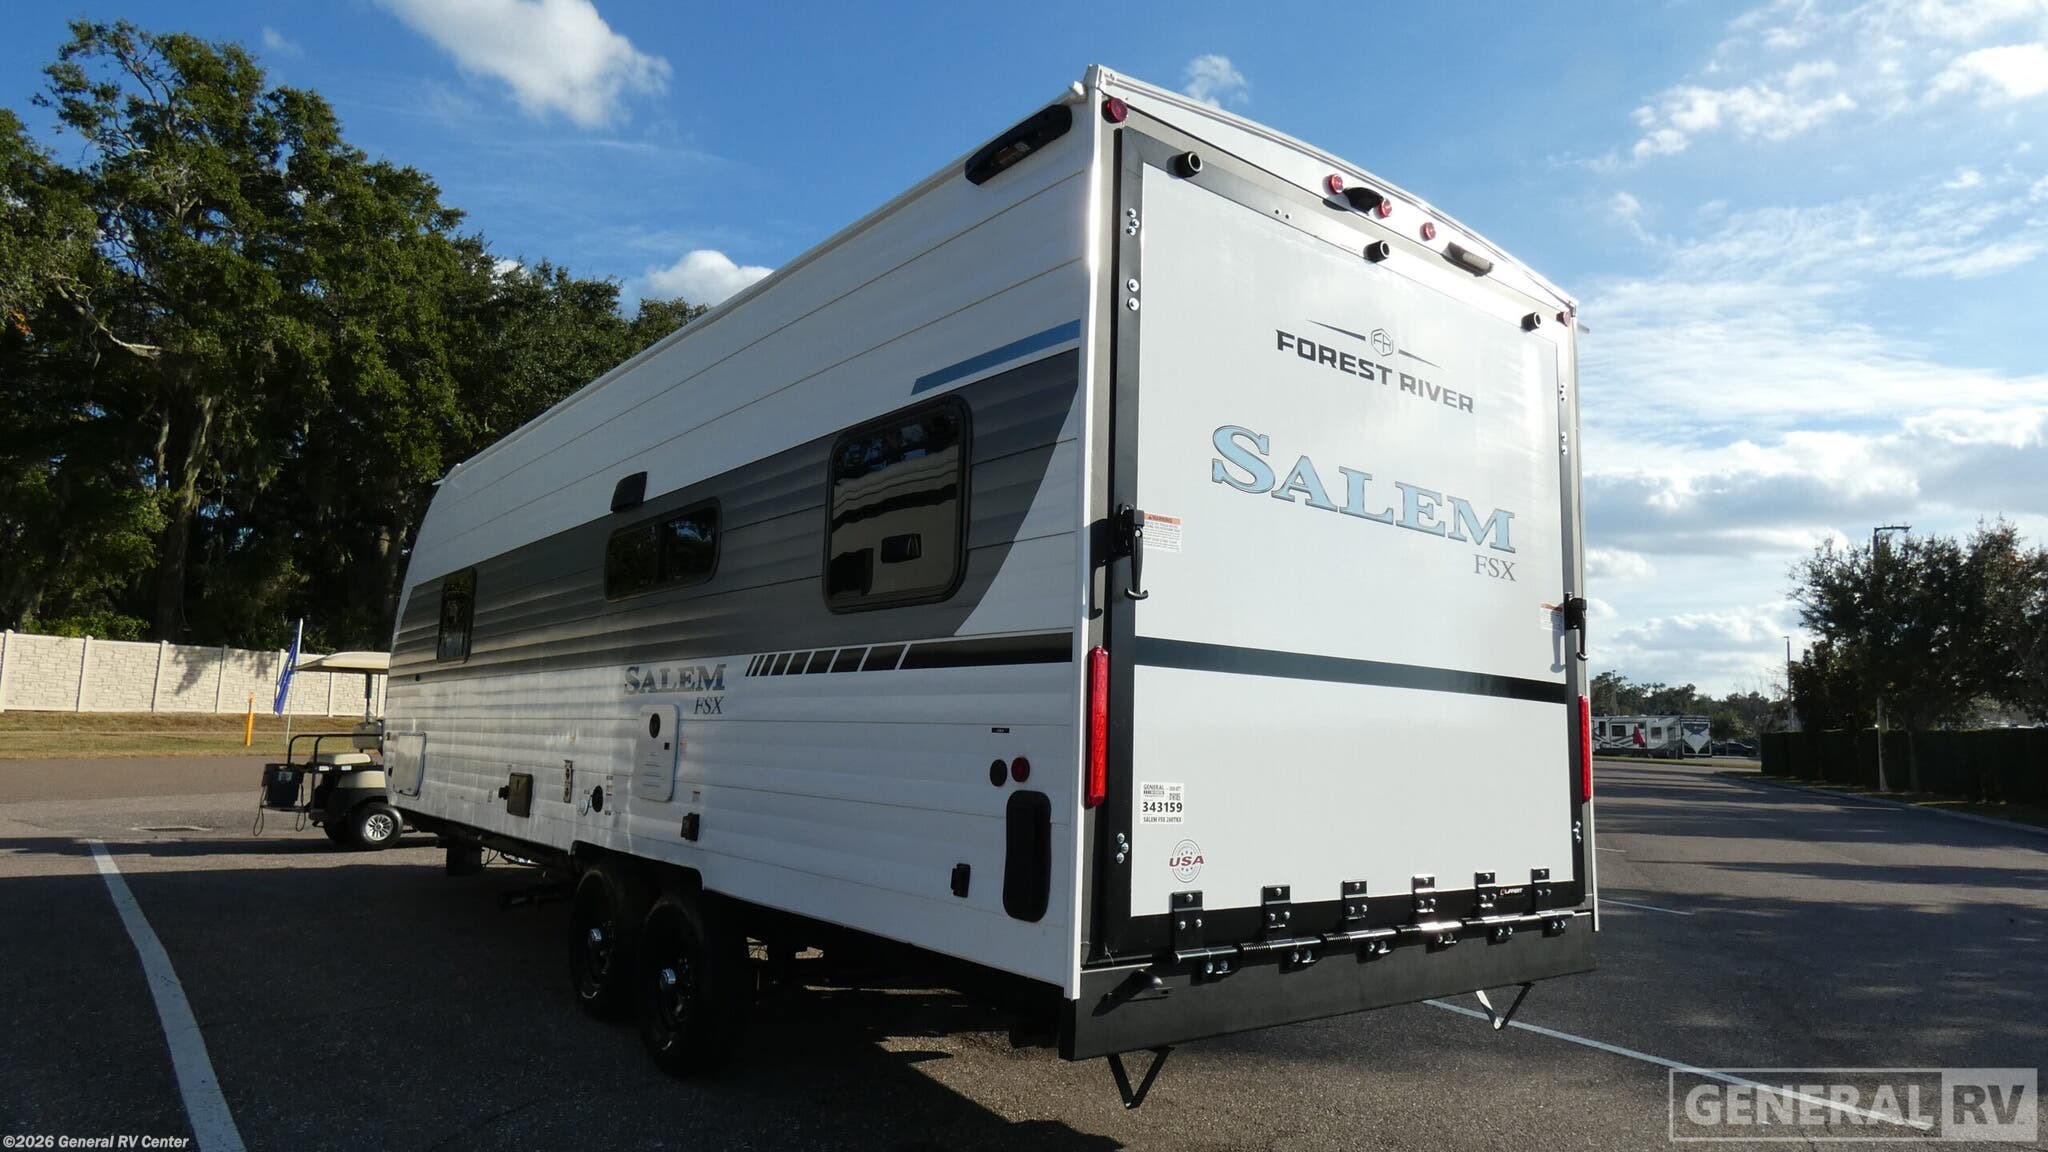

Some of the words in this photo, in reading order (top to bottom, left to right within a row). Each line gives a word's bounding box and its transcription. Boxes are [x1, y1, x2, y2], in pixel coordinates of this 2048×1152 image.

[1276, 329, 1393, 386] FOREST
[1399, 372, 1474, 414] RIVER
[1212, 425, 1516, 553] SALEM
[1473, 554, 1517, 582] FSX
[623, 664, 727, 695] SALEM
[693, 696, 725, 714] FSX
[1142, 801, 1183, 813] 343159
[1169, 855, 1205, 867] USA
